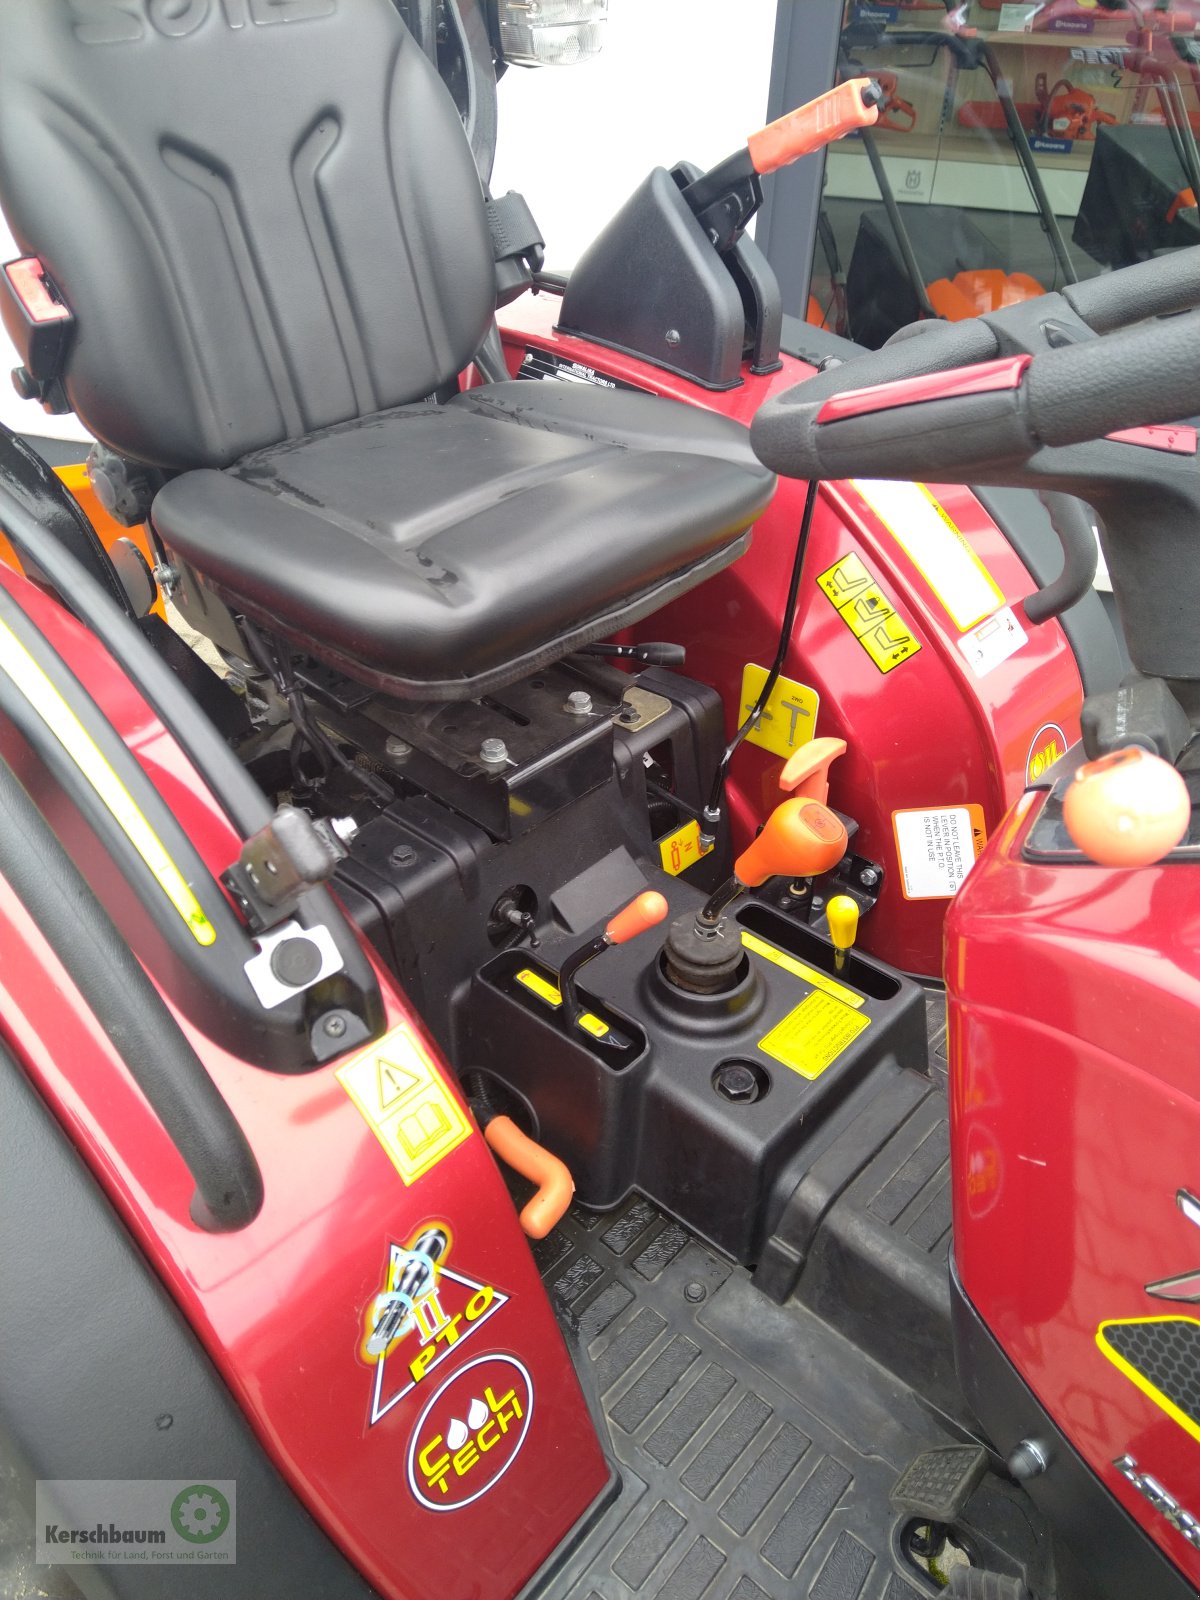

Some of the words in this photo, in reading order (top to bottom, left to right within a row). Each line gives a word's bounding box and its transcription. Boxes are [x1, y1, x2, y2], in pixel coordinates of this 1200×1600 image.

[939, 512, 972, 554] WARNING
[932, 815, 941, 836] WHEN
[940, 815, 950, 837] LEVER
[949, 814, 957, 825] DO
[924, 824, 933, 838] NOT
[950, 826, 959, 841] NOT
[927, 848, 936, 862] USE
[944, 846, 955, 878] POSITION
[952, 842, 962, 863] LEAVE
[955, 864, 964, 879] THIS
[409, 1286, 495, 1383] PTO
[428, 1396, 523, 1494] TECH
